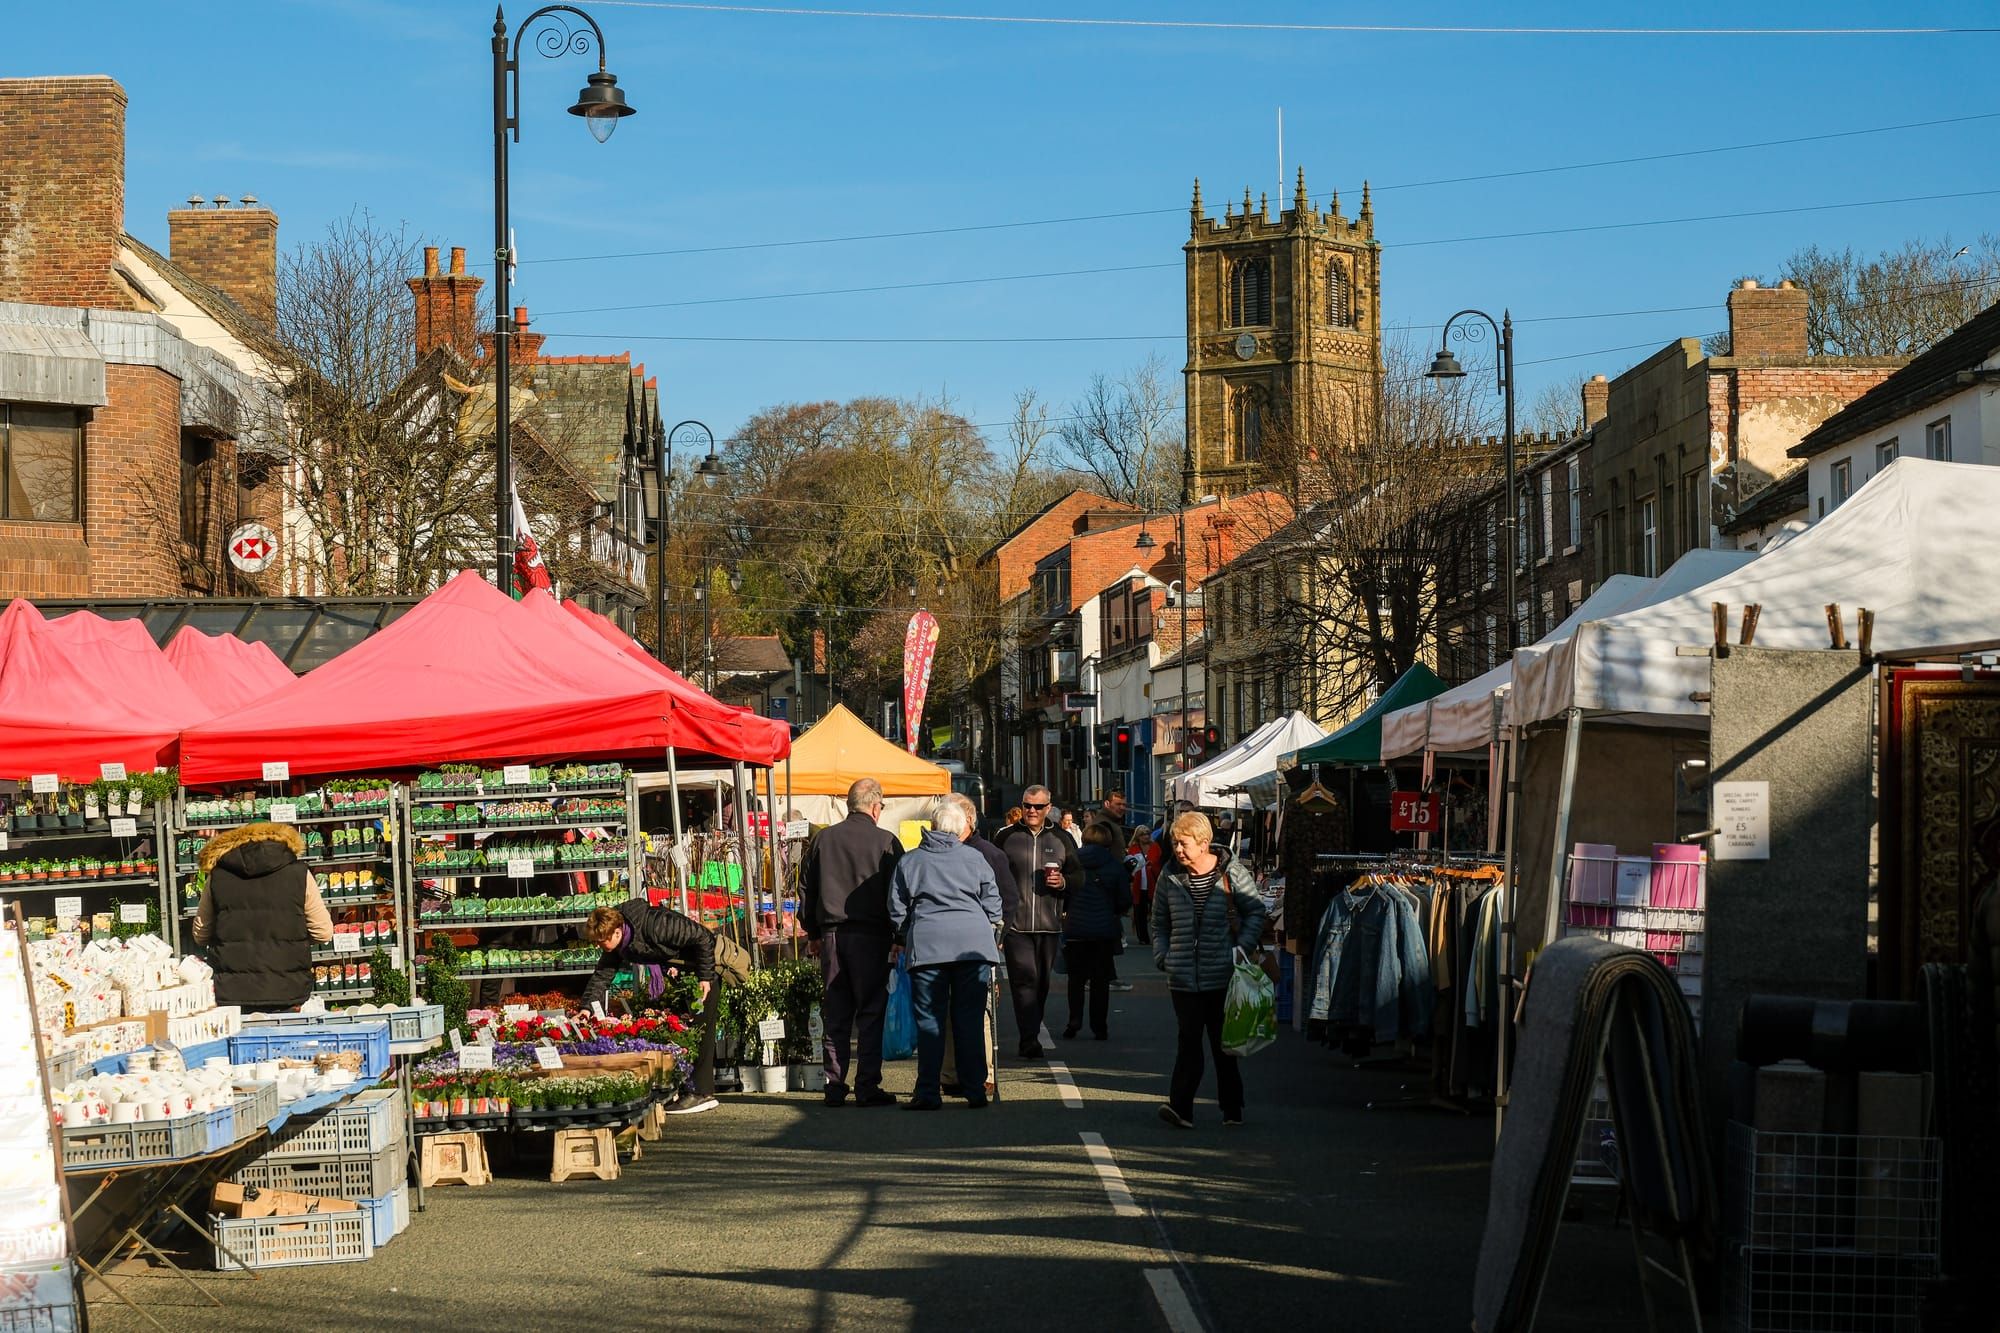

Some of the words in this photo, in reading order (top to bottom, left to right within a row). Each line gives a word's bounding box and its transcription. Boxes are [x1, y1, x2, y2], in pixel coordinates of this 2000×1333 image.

[907, 660, 921, 711] REMINISCE
[917, 619, 929, 658] SWEETS
[1399, 800, 1430, 824] £15
[1736, 823, 1746, 831] £5
